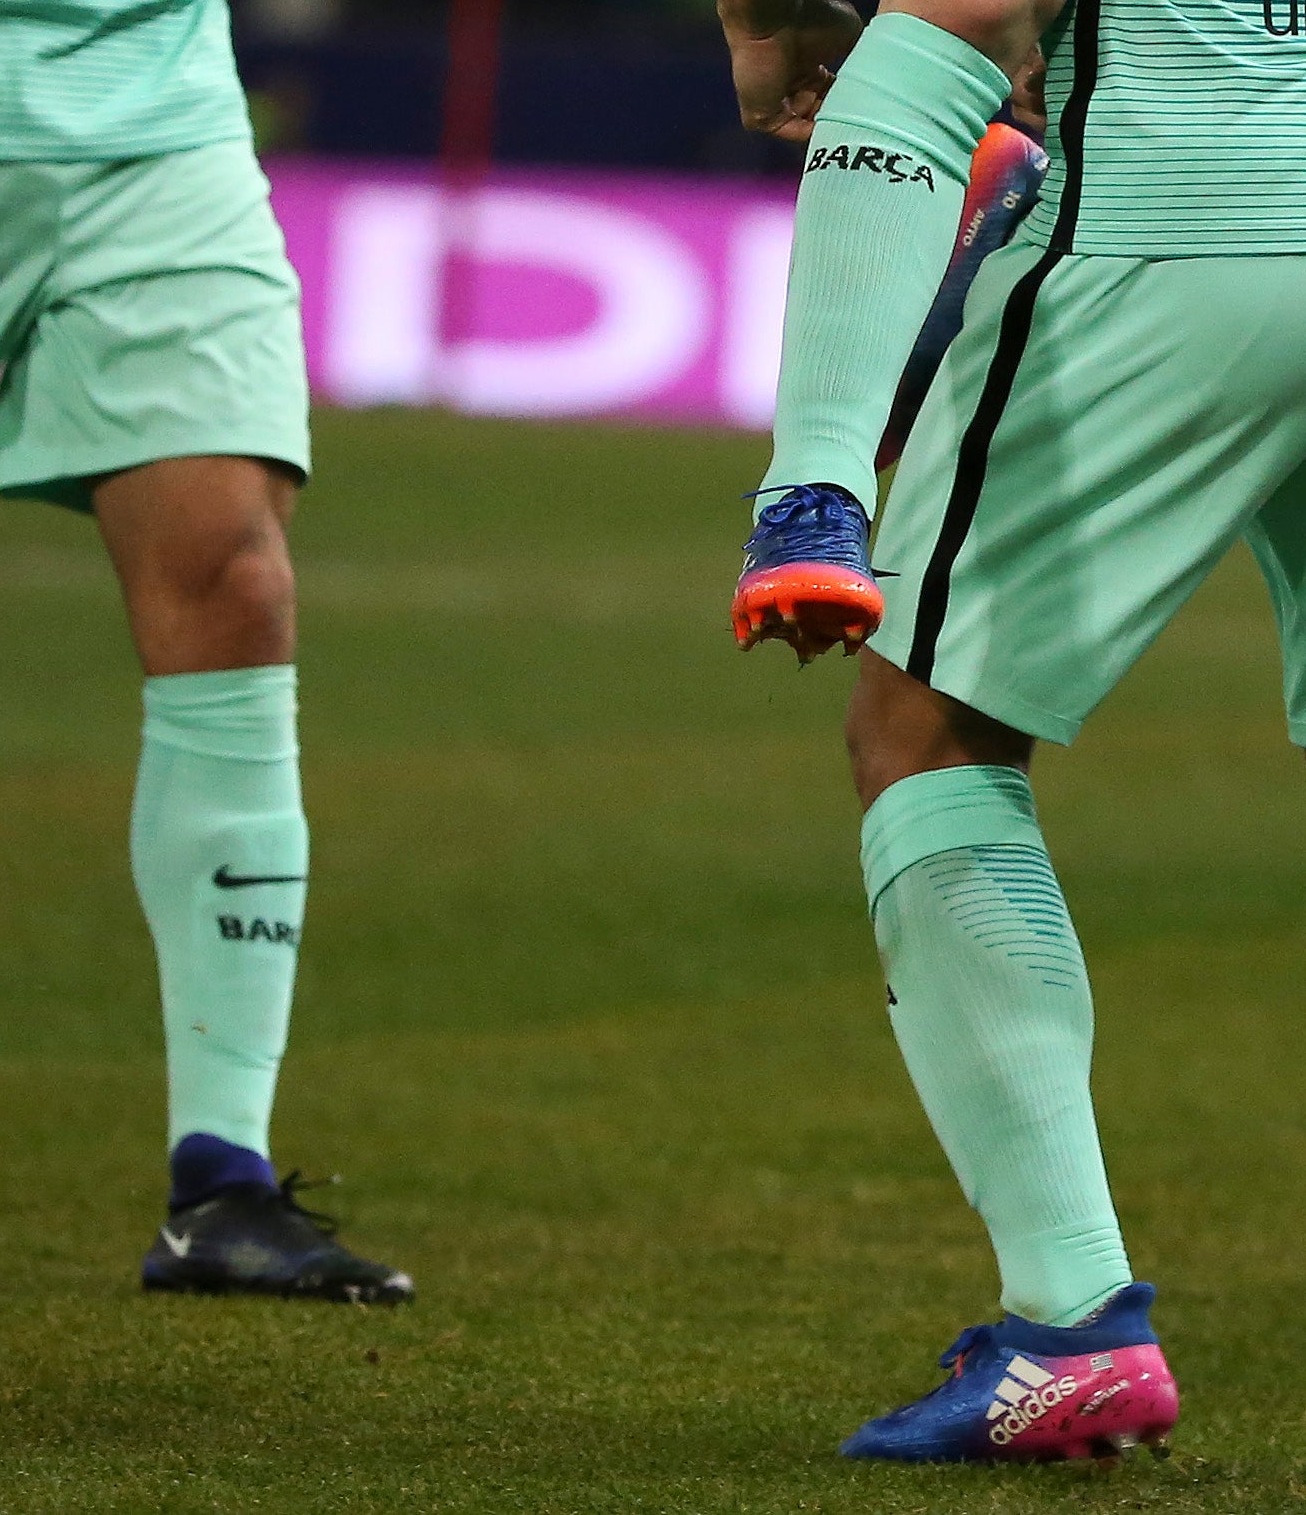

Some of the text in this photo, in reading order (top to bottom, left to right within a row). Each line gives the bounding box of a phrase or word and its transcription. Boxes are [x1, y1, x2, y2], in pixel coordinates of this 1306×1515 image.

[805, 145, 935, 193] BARÇA
[216, 913, 300, 948] BAR
[989, 1374, 1078, 1446] adidas
